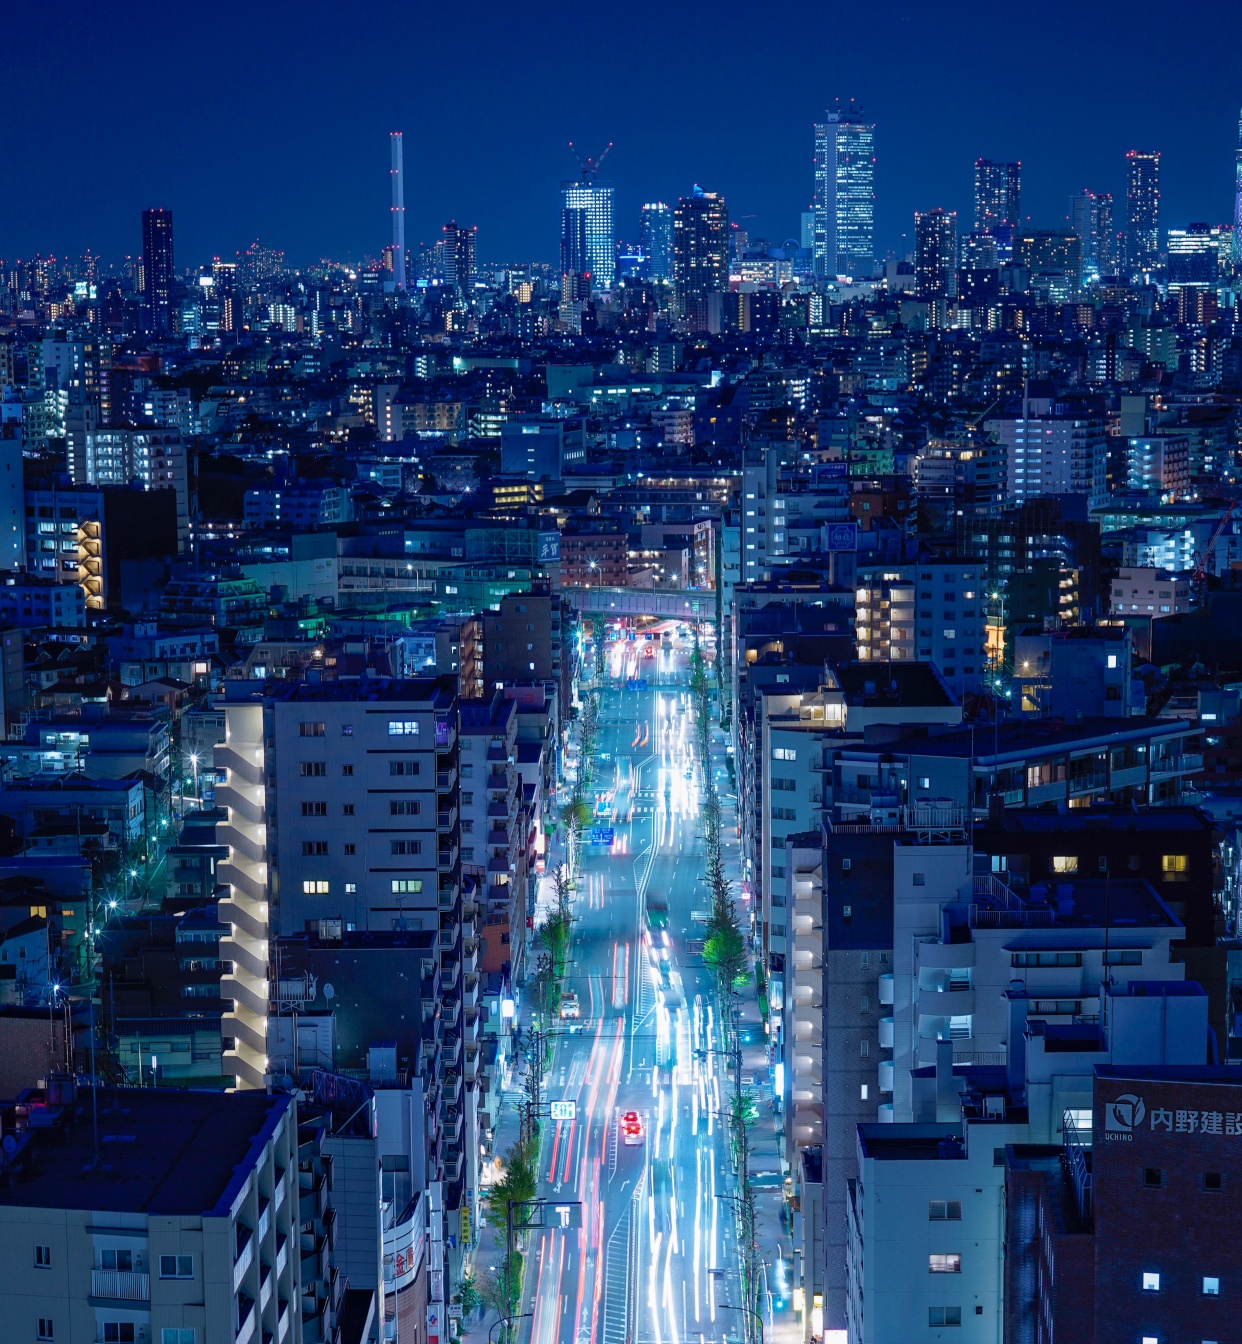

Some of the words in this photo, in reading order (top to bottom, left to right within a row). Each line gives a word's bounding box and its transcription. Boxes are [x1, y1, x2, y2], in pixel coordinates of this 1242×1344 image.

[1150, 1107, 1242, 1136] 内野建設
[1104, 1132, 1133, 1142] UCHINO
